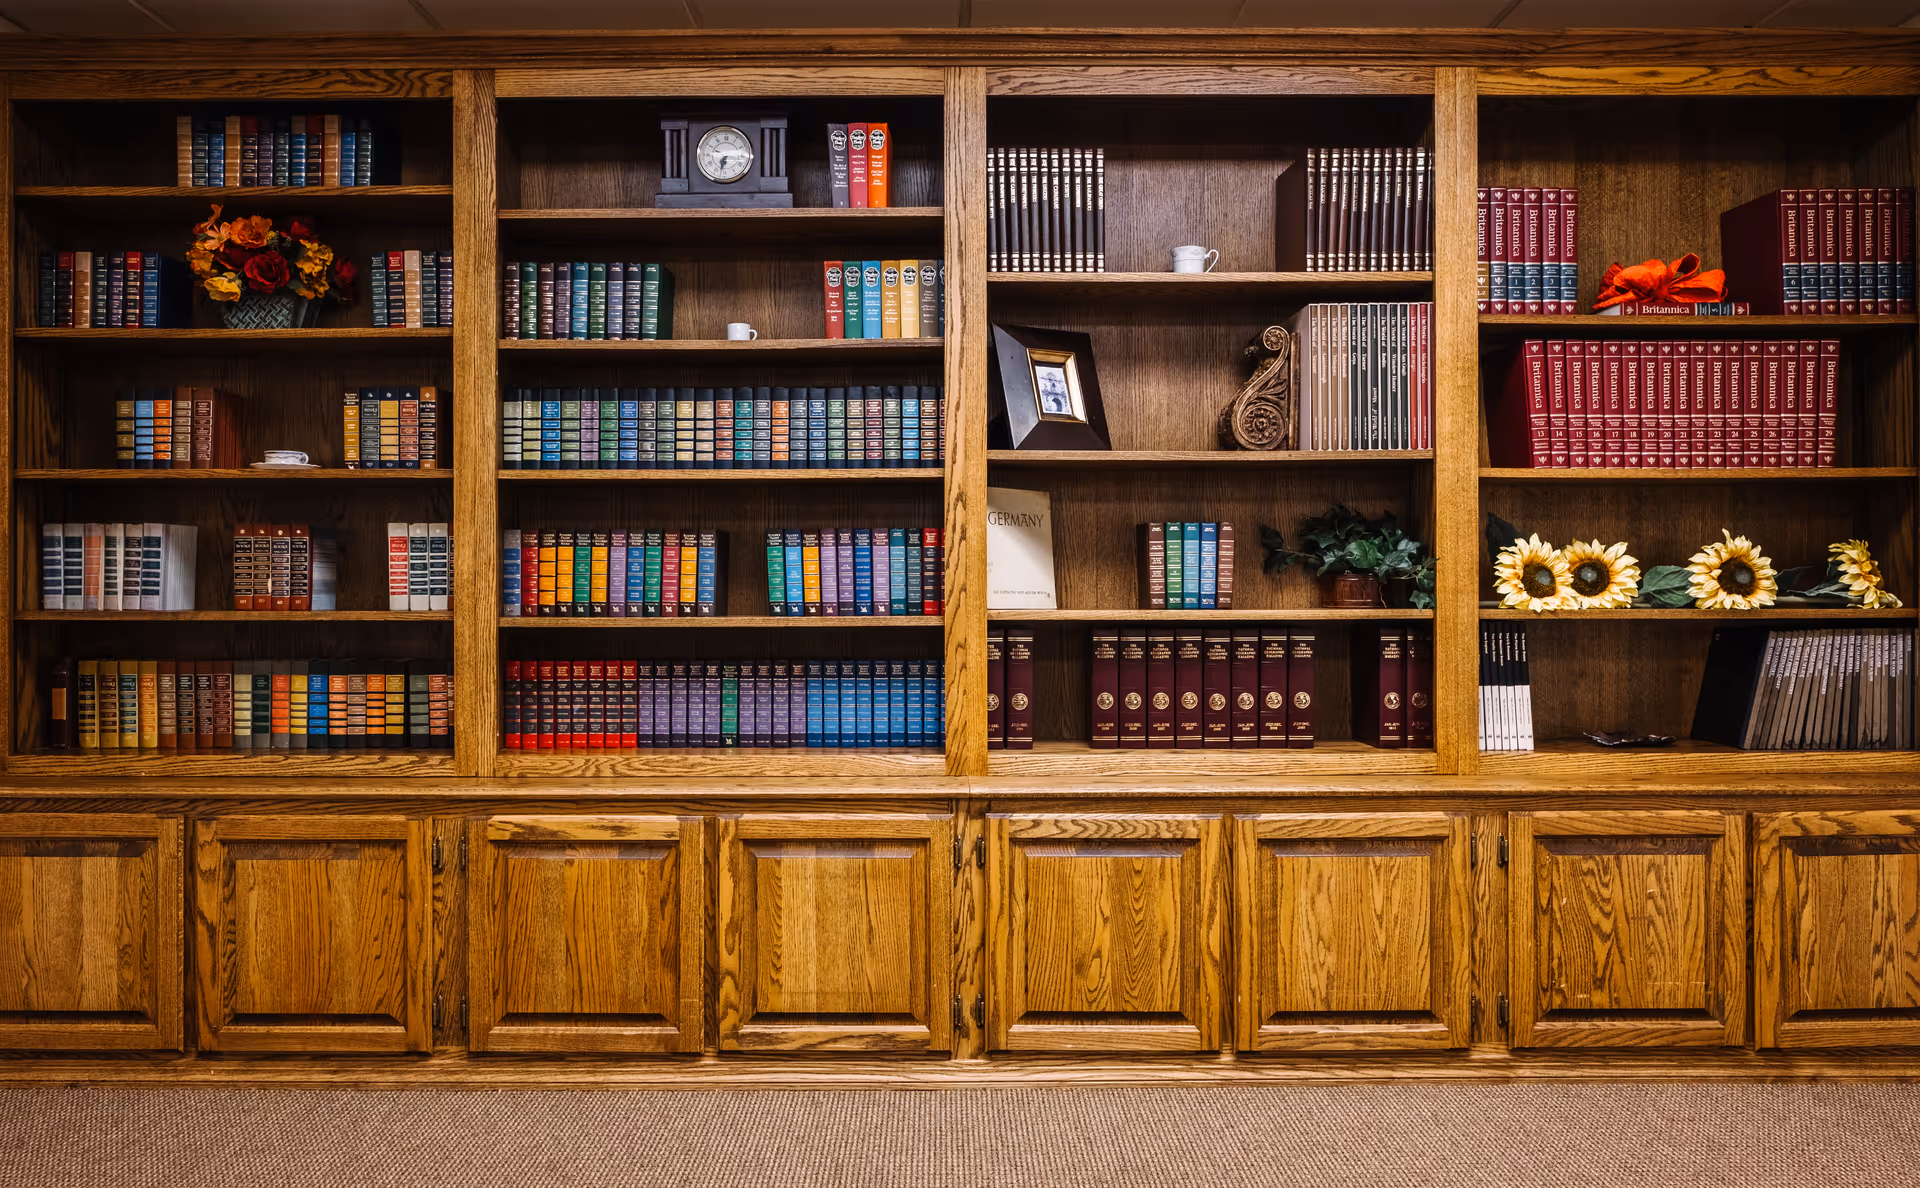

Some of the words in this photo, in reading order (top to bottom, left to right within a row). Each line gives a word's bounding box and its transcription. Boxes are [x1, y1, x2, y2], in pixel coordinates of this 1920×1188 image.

[1478, 208, 1487, 256] Britannica
[1495, 208, 1504, 256] Britannica
[1513, 209, 1521, 257] Britannica
[1529, 209, 1538, 257] Britannica
[1548, 209, 1557, 257] Britannica
[1566, 209, 1575, 257] Britannica
[1787, 210, 1797, 257] Britannica
[1807, 209, 1816, 257] Britannica
[1826, 209, 1835, 257] Britannica
[1845, 209, 1854, 257] Britannica
[1865, 209, 1873, 256] Britannica
[1884, 208, 1892, 256] Britannica
[1642, 305, 1690, 314] Britannica
[1532, 361, 1543, 408] Britannica
[1554, 361, 1563, 408] Britannica
[1573, 361, 1582, 409] Britannica
[1591, 361, 1600, 409] Britannica
[1610, 362, 1619, 409] Britannica
[1629, 361, 1637, 409] Britannica
[1647, 361, 1656, 409] Britannica
[1663, 362, 1672, 409] Britannica
[1679, 362, 1688, 409] Britannica
[1696, 361, 1705, 409] Britannica
[1713, 361, 1722, 409] Britannica
[1731, 362, 1740, 409] Britannica
[1750, 361, 1759, 409] Britannica
[1769, 362, 1778, 409] Britannica
[1787, 361, 1796, 408] Britannica
[1806, 361, 1815, 408] Britannica
[1826, 361, 1836, 408] Britannica
[988, 511, 1043, 528] GERMANY
